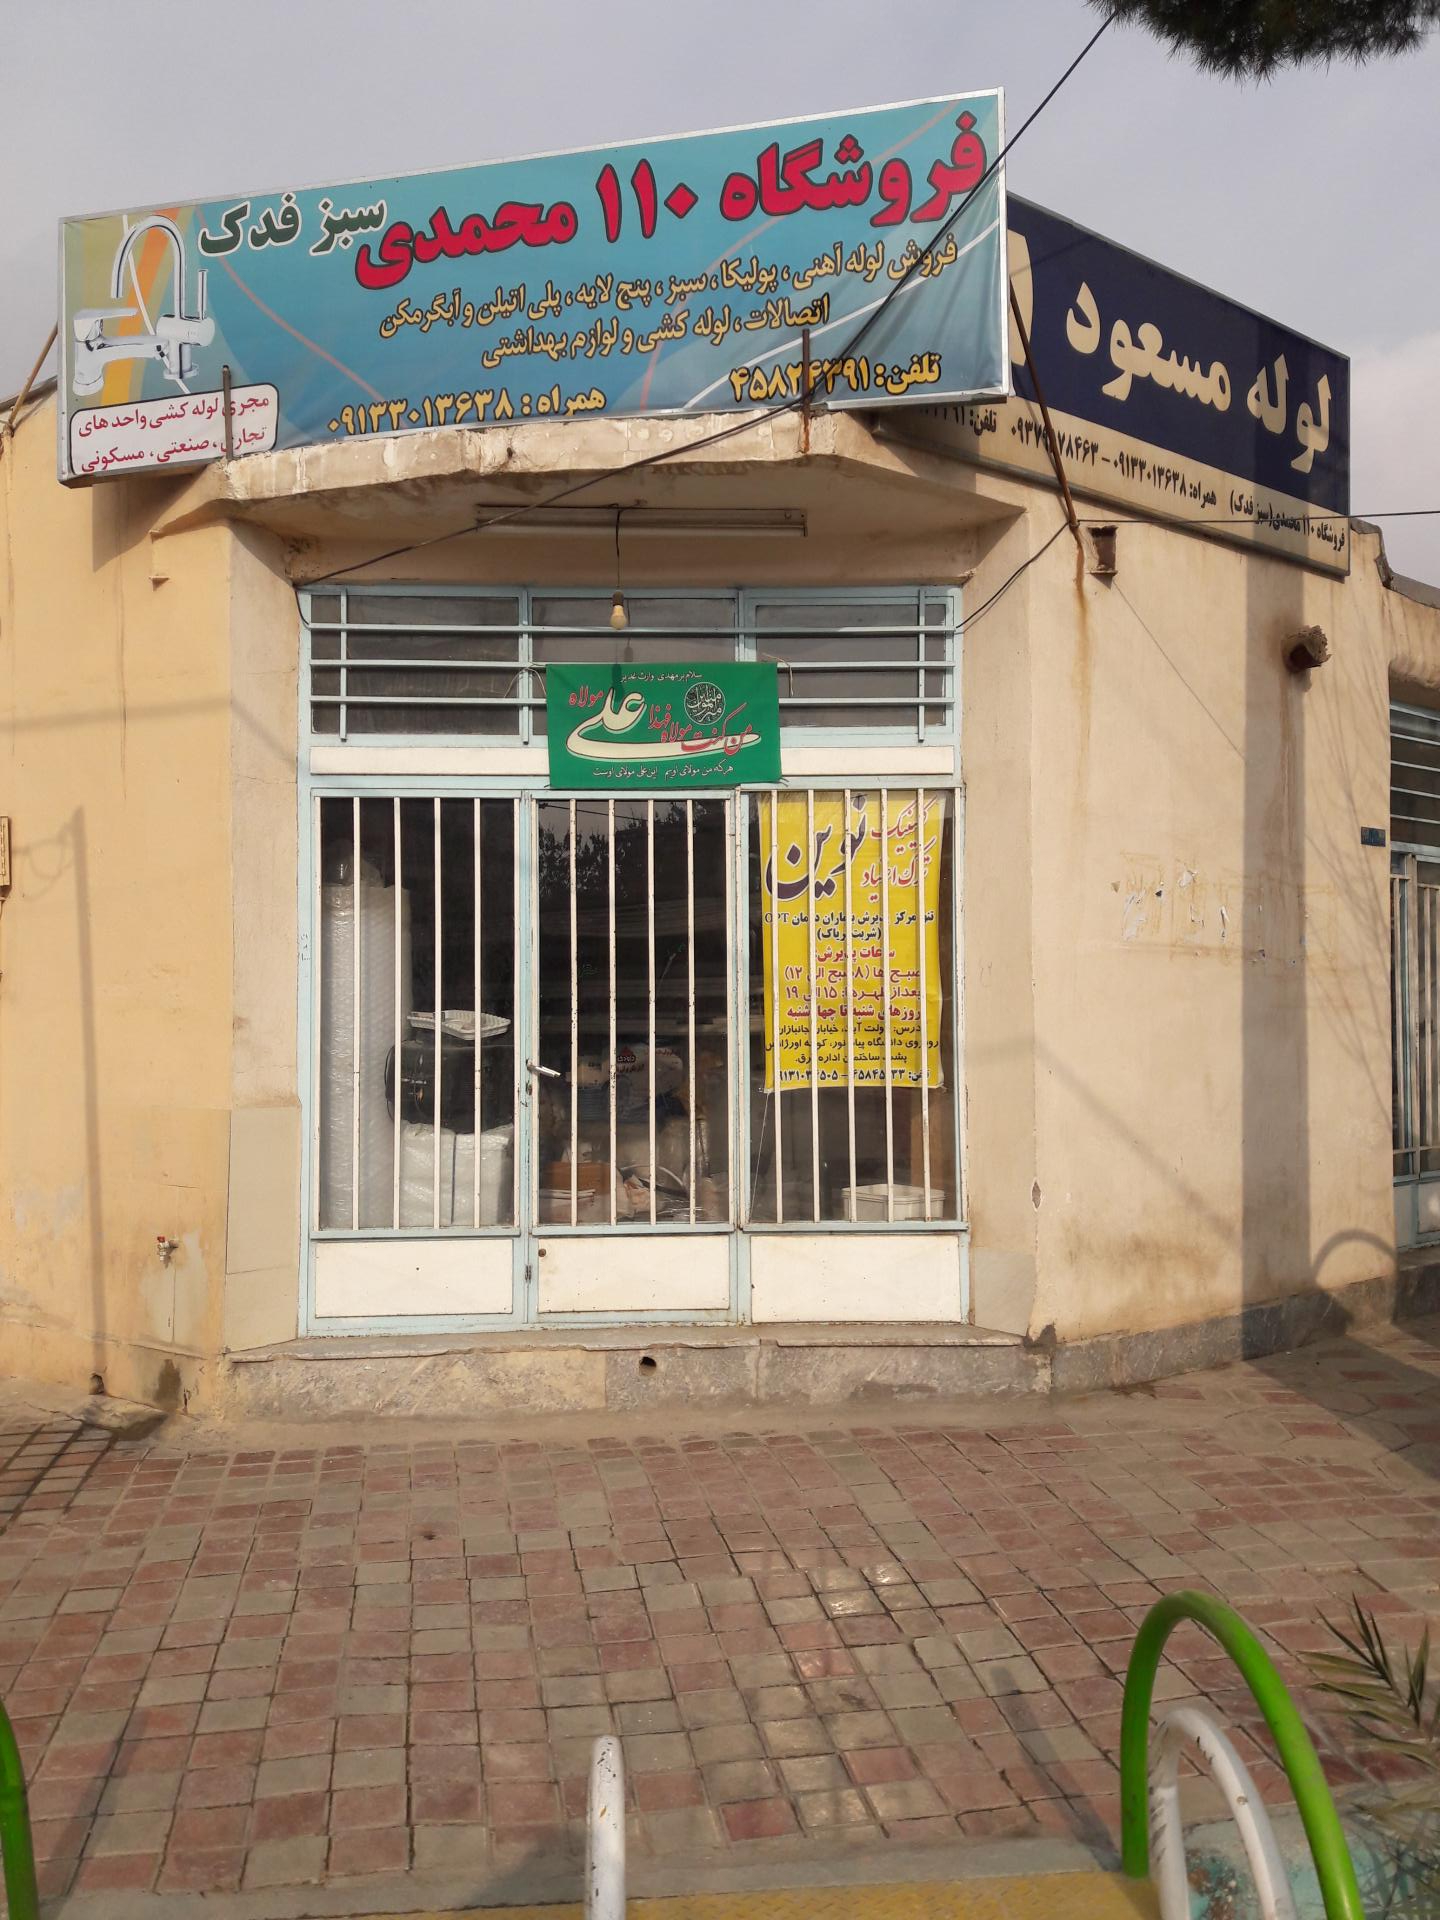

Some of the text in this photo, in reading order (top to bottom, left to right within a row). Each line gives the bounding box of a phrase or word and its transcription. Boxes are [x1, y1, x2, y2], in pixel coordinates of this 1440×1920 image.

[355, 110, 987, 290] فروشگاه ۱۱۰ محمدی
[198, 191, 388, 257] سبز فدک
[845, 240, 886, 282] لوله
[887, 234, 959, 279] فروش
[476, 283, 526, 325] اتیلن
[527, 280, 562, 320] پلی
[616, 279, 651, 310] پنج
[461, 301, 476, 328] و
[693, 304, 732, 346] لوله
[570, 316, 619, 359] لوازم
[620, 327, 635, 355] و
[636, 309, 690, 353] کشی
[481, 326, 568, 369] بهداشتی
[874, 351, 942, 395] تلفن:
[1066, 281, 1332, 474] لوله مسعود
[149, 402, 189, 428] کشی
[192, 398, 218, 420] لوله
[221, 396, 269, 416] مجری
[328, 388, 514, 435] ۰۹۱۳۳۰۱۳۶۳۸
[1011, 416, 1099, 466] ۰۹۳۷۹۷۸۴۶۳
[81, 446, 145, 473] مسکونی
[1113, 450, 1187, 498] ۰۹۱۳۳۰۱۳۶۳۸
[1316, 522, 1345, 552] فروشگاه
[568, 685, 603, 708] مولاه
[566, 686, 761, 762] علی
[723, 724, 753, 756] من
[871, 795, 938, 850] کینیک
[792, 911, 820, 926] دمان
[823, 911, 856, 925] بماران
[858, 911, 889, 925] یرش
[894, 911, 917, 925] مرکز
[817, 928, 848, 941] ریاک)
[860, 945, 896, 958] سعات
[786, 985, 799, 999] ۱۹
[803, 986, 820, 1002] ای
[823, 986, 837, 999] ۱۵
[864, 1023, 885, 1035] ولت
[867, 1036, 903, 1048] دانگاه
[893, 1025, 921, 1035] درس:
[765, 1037, 802, 1052] اورژاس
[803, 1038, 827, 1051] کوه
[852, 1038, 865, 1050] پیا
[818, 1052, 841, 1064] اداره
[842, 1051, 881, 1064] ساختمن
[779, 1068, 839, 1081] ۱۳۱۰۳۵۰۵
[853, 1068, 906, 1081] ۴۵۸۴۵۳۳
